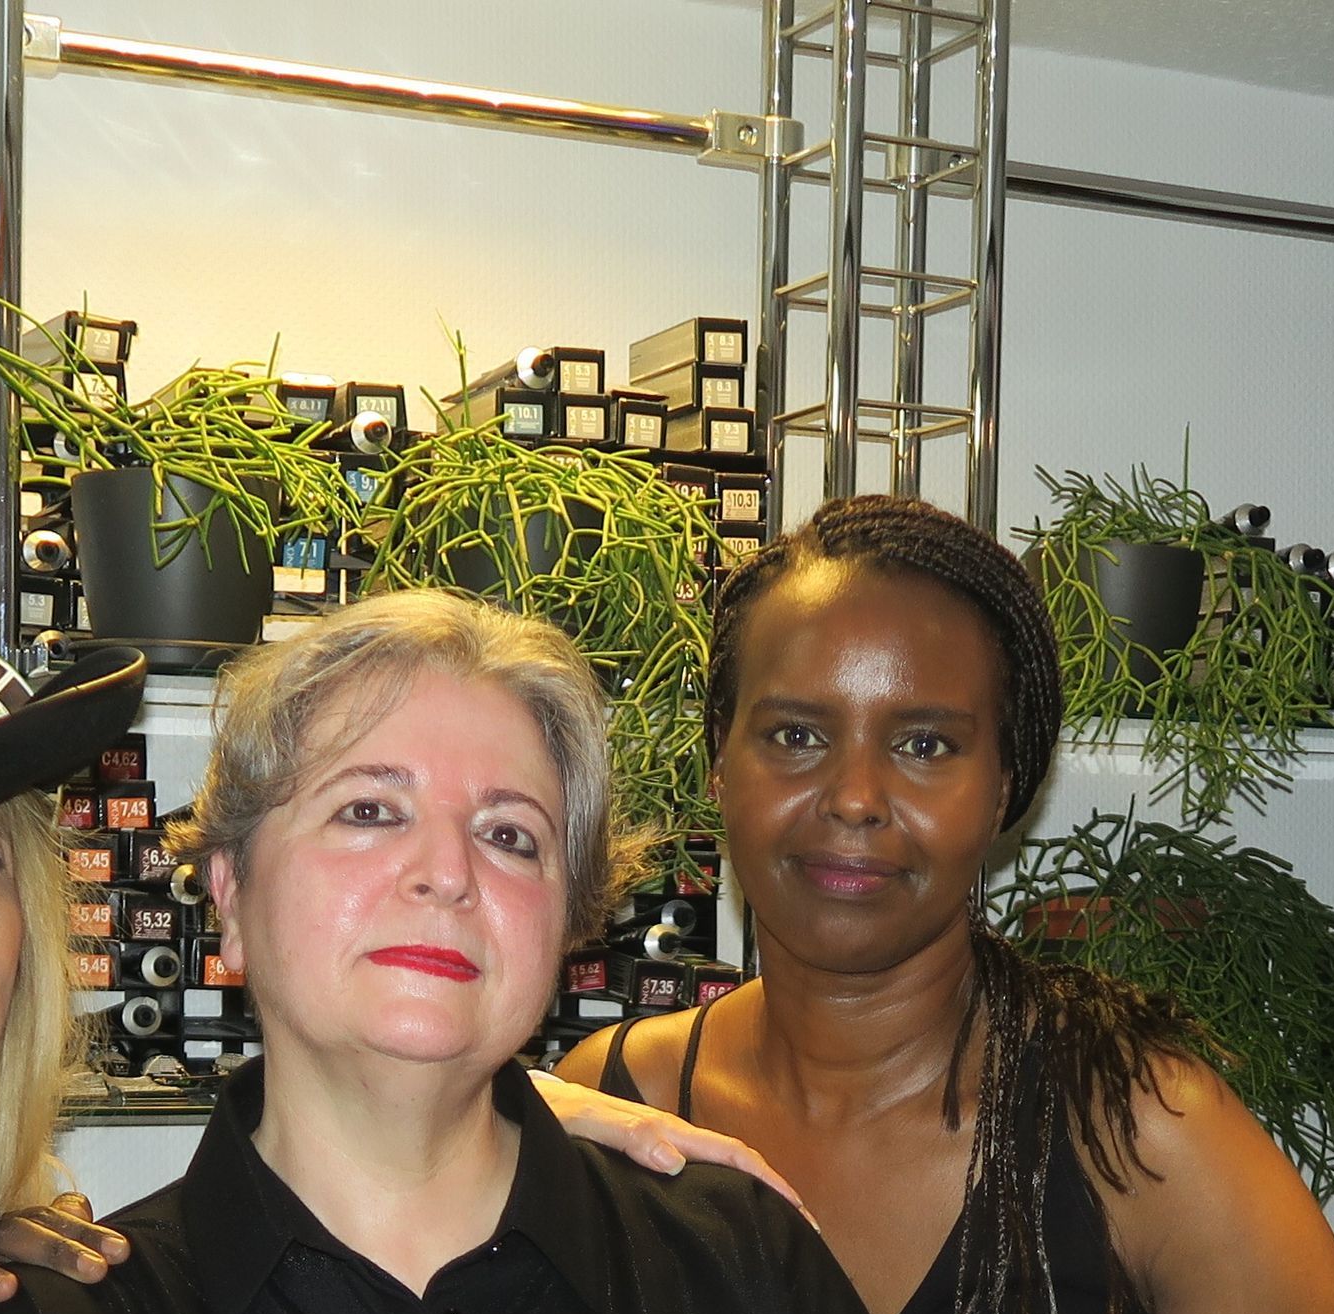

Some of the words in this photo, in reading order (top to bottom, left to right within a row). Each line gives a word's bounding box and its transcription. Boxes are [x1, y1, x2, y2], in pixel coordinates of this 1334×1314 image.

[518, 407, 538, 418] 10.1
[732, 493, 757, 509] 10,31
[101, 751, 138, 767] C4,62
[120, 801, 148, 818] 7,43
[80, 852, 110, 869] 5,45
[80, 907, 110, 923] 5,45
[142, 912, 172, 929] 5,32
[79, 957, 109, 974] 5,45
[650, 979, 675, 995] 7,35
